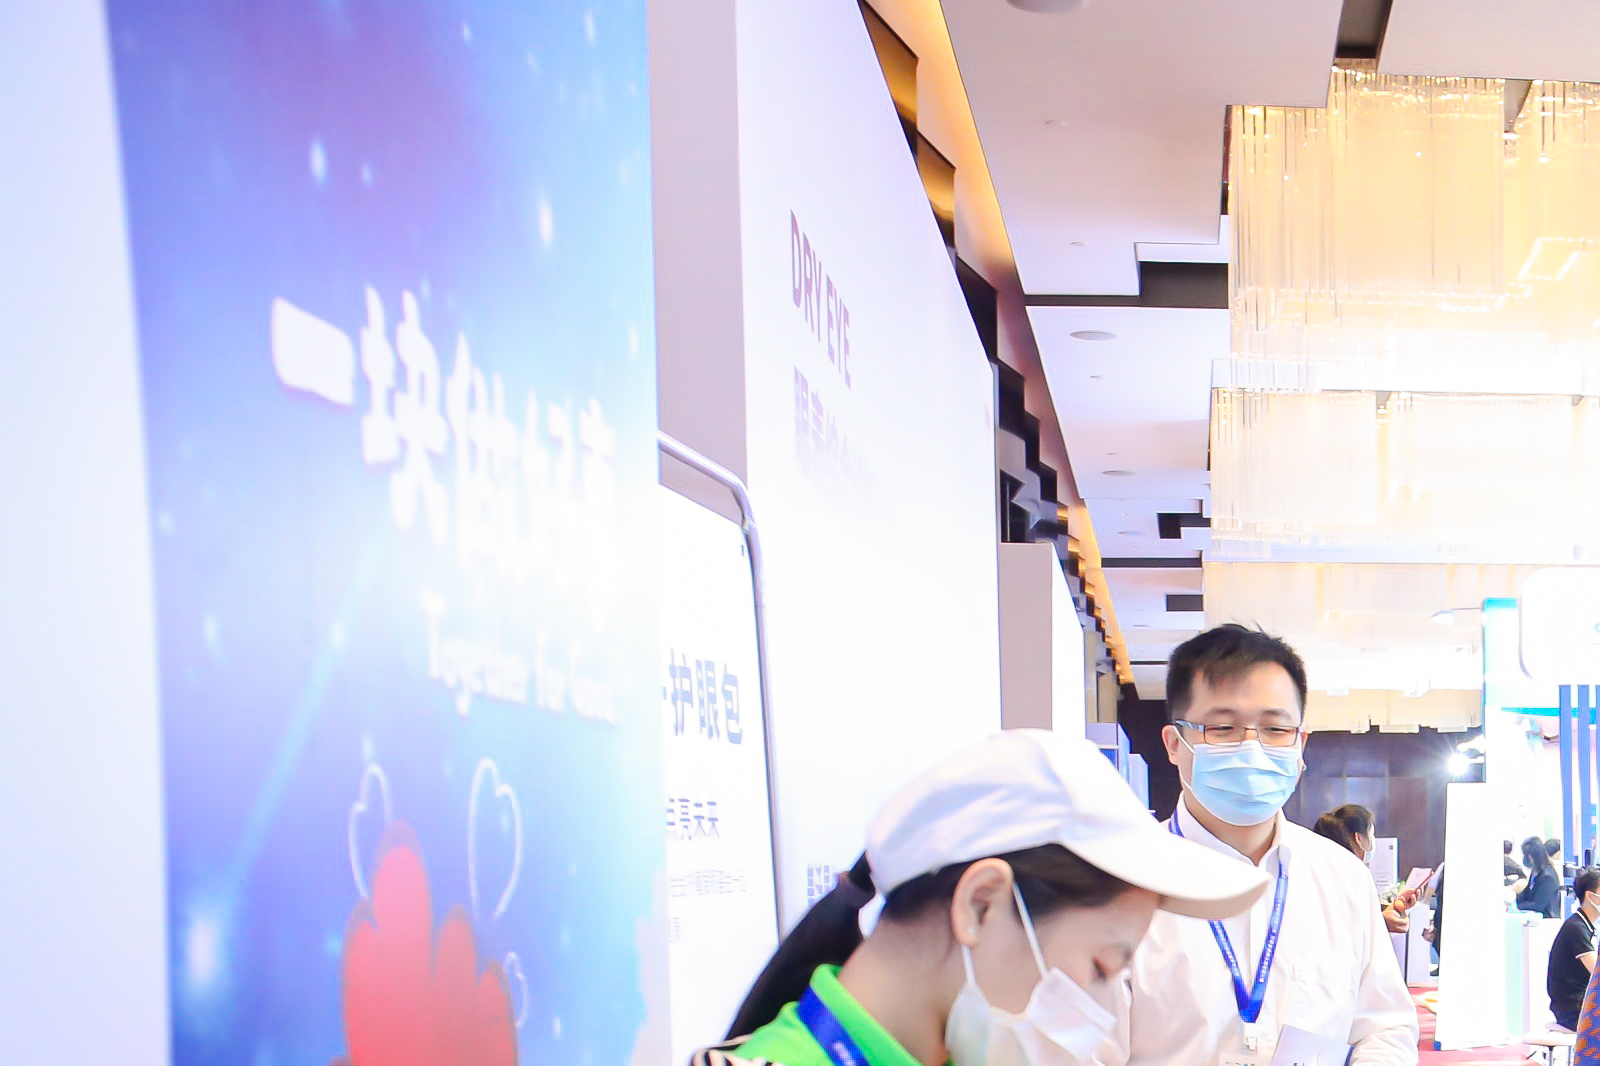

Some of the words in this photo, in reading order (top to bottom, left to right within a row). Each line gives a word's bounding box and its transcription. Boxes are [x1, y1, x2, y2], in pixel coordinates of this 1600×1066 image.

[790, 208, 822, 343] DRY
[826, 273, 852, 391] EYE
[662, 647, 744, 745] 护眼包
